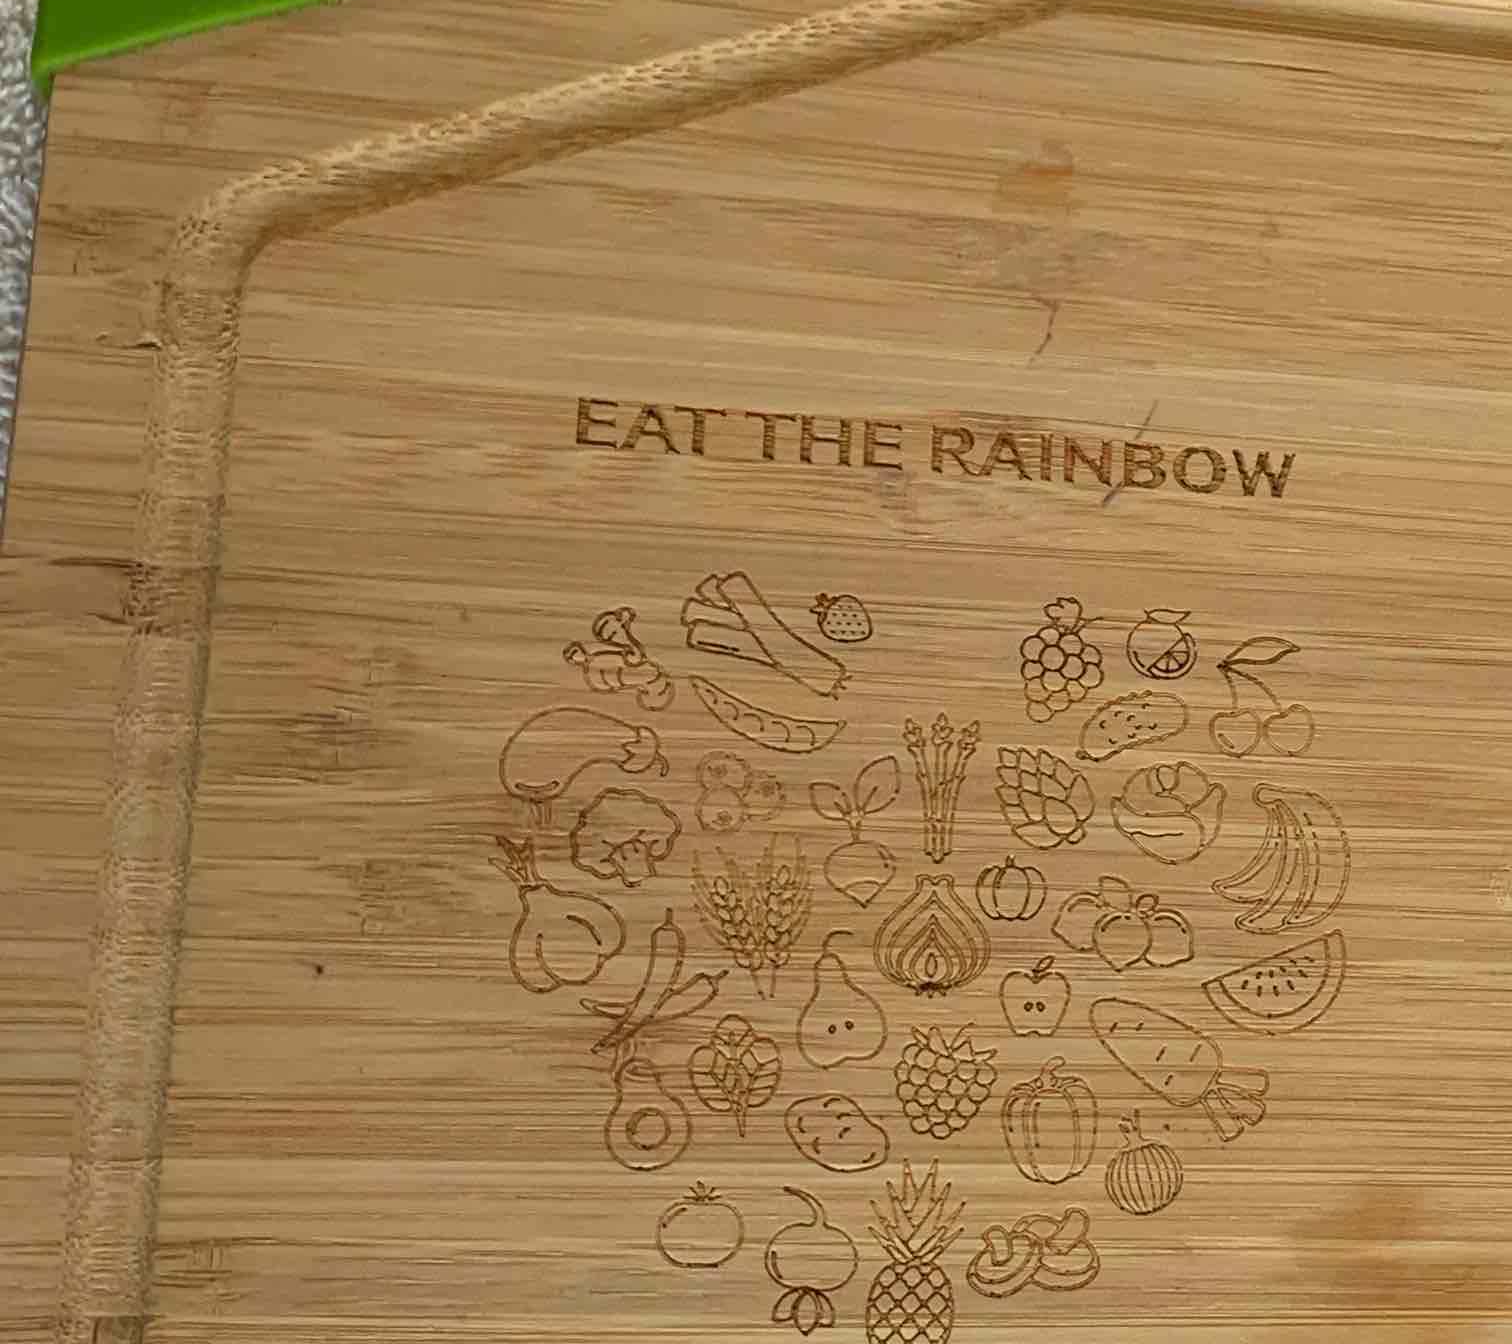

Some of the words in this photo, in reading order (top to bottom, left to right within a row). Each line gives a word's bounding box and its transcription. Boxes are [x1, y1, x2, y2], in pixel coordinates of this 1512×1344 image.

[575, 397, 726, 455] EAT
[746, 411, 902, 470] THE
[930, 422, 1297, 499] RAINBOW
